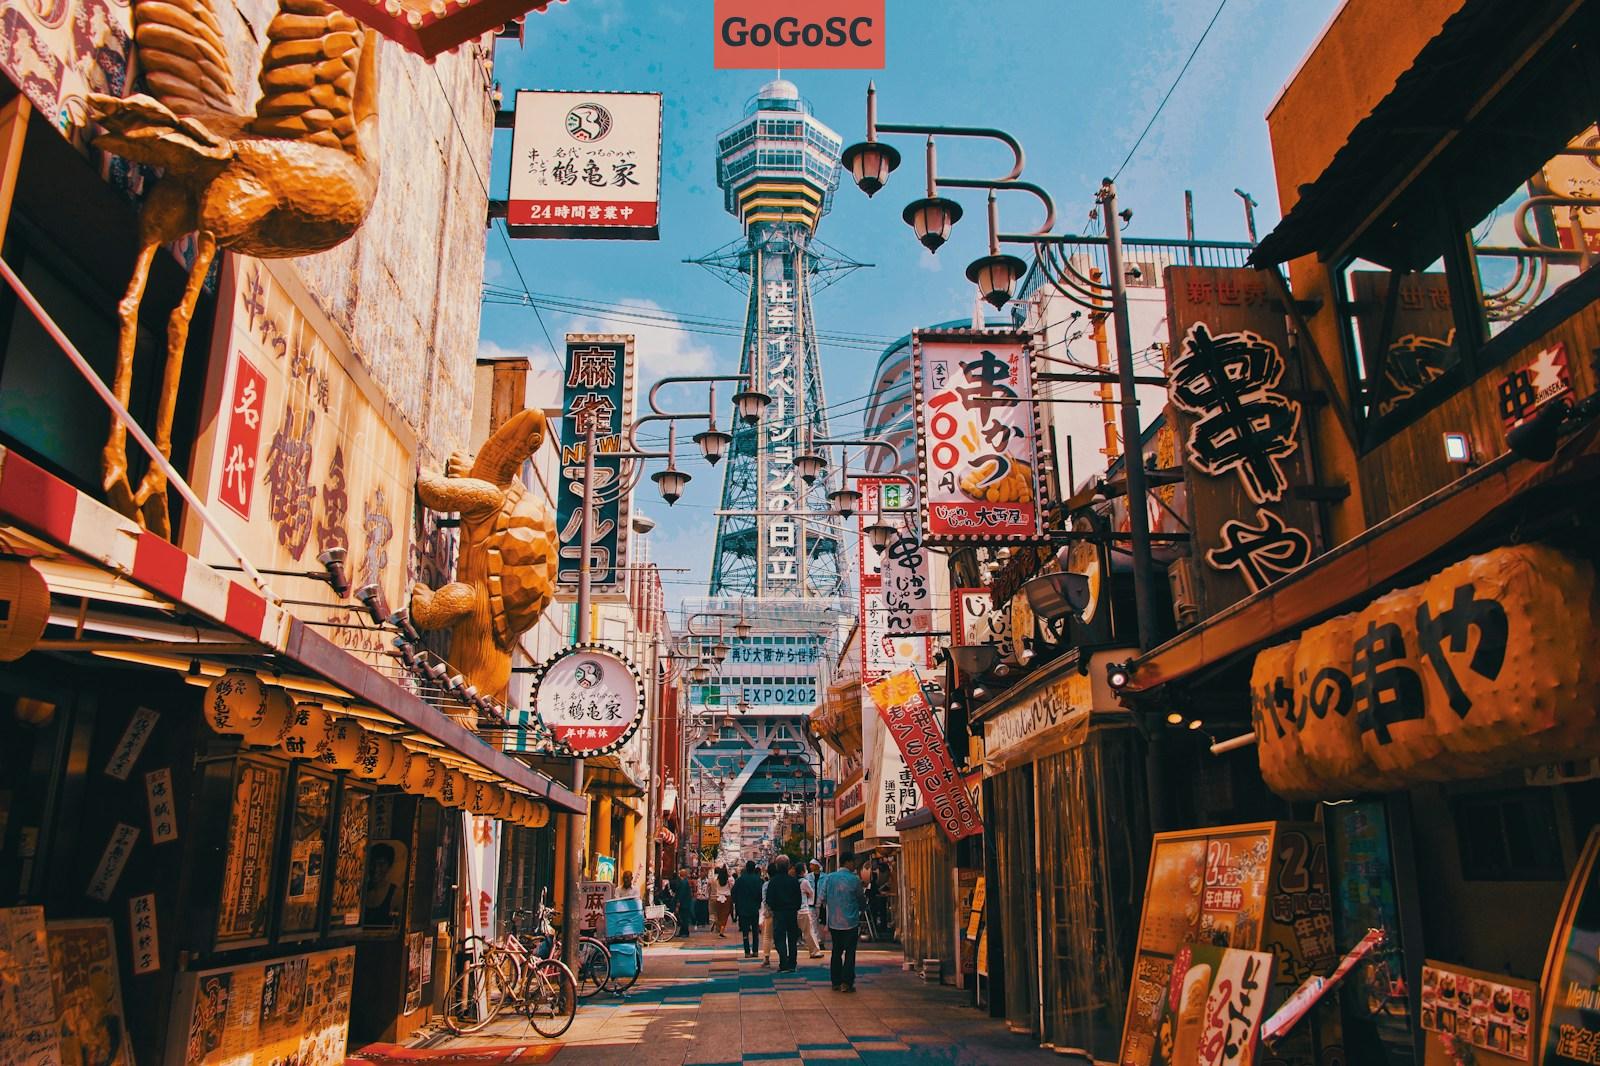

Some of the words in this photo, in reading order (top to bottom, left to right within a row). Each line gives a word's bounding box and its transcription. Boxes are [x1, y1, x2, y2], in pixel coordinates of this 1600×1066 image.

[531, 204, 634, 220] 24時間営業中
[552, 157, 640, 187] 鶴亀家
[1187, 282, 1266, 306] 新世界
[565, 346, 617, 435] 麻雀
[767, 280, 797, 581] 社会イノベーションの日立
[955, 350, 1025, 488] 串かつ
[225, 381, 262, 506] 名代
[1168, 321, 1311, 594] 串や
[568, 700, 623, 720] 鶴亀家
